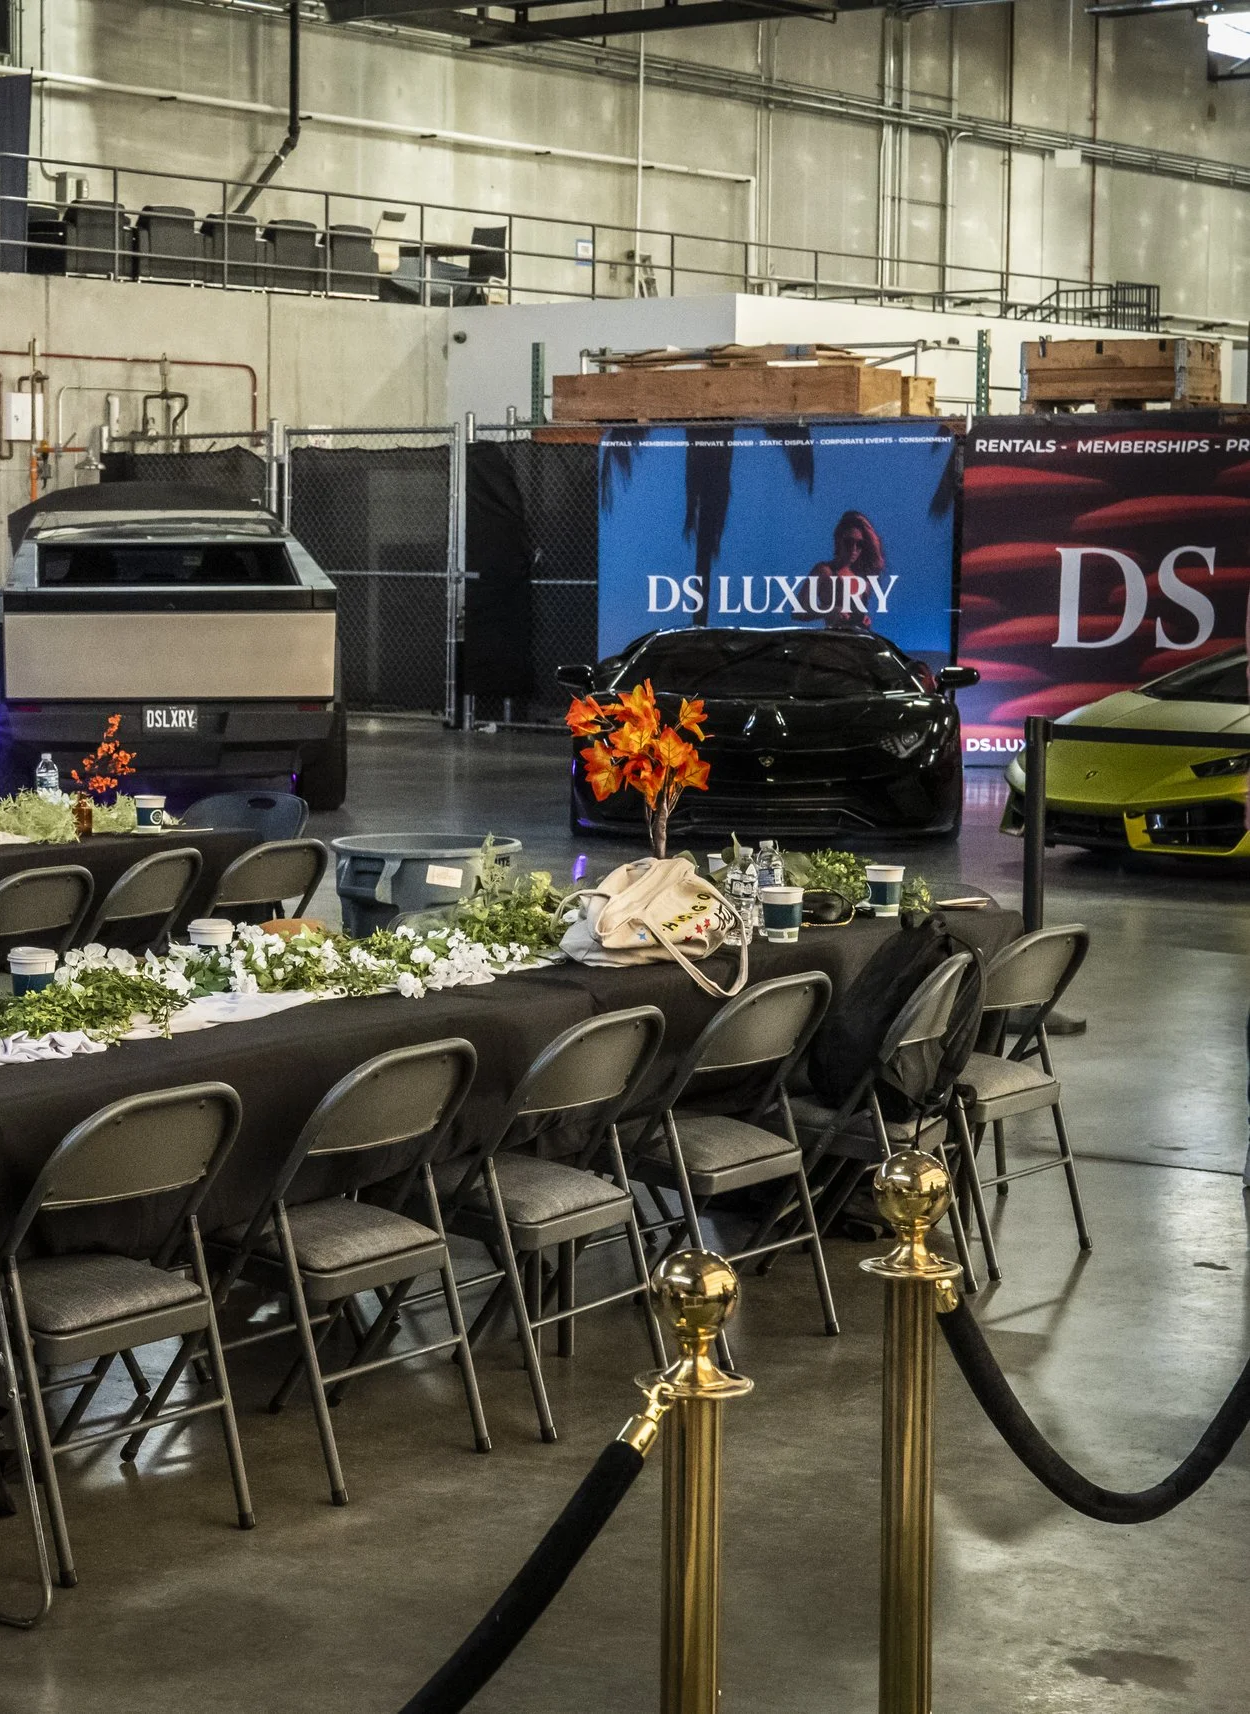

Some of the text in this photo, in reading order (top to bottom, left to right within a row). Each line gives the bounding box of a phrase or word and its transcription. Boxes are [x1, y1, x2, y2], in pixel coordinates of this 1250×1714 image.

[865, 437, 893, 445] EVENTS
[975, 438, 1250, 454] RENTALS MEMBERSHIPS PR
[647, 574, 899, 614] DS LUXURY
[1052, 545, 1216, 650] DS
[146, 709, 195, 728] DSLXRY
